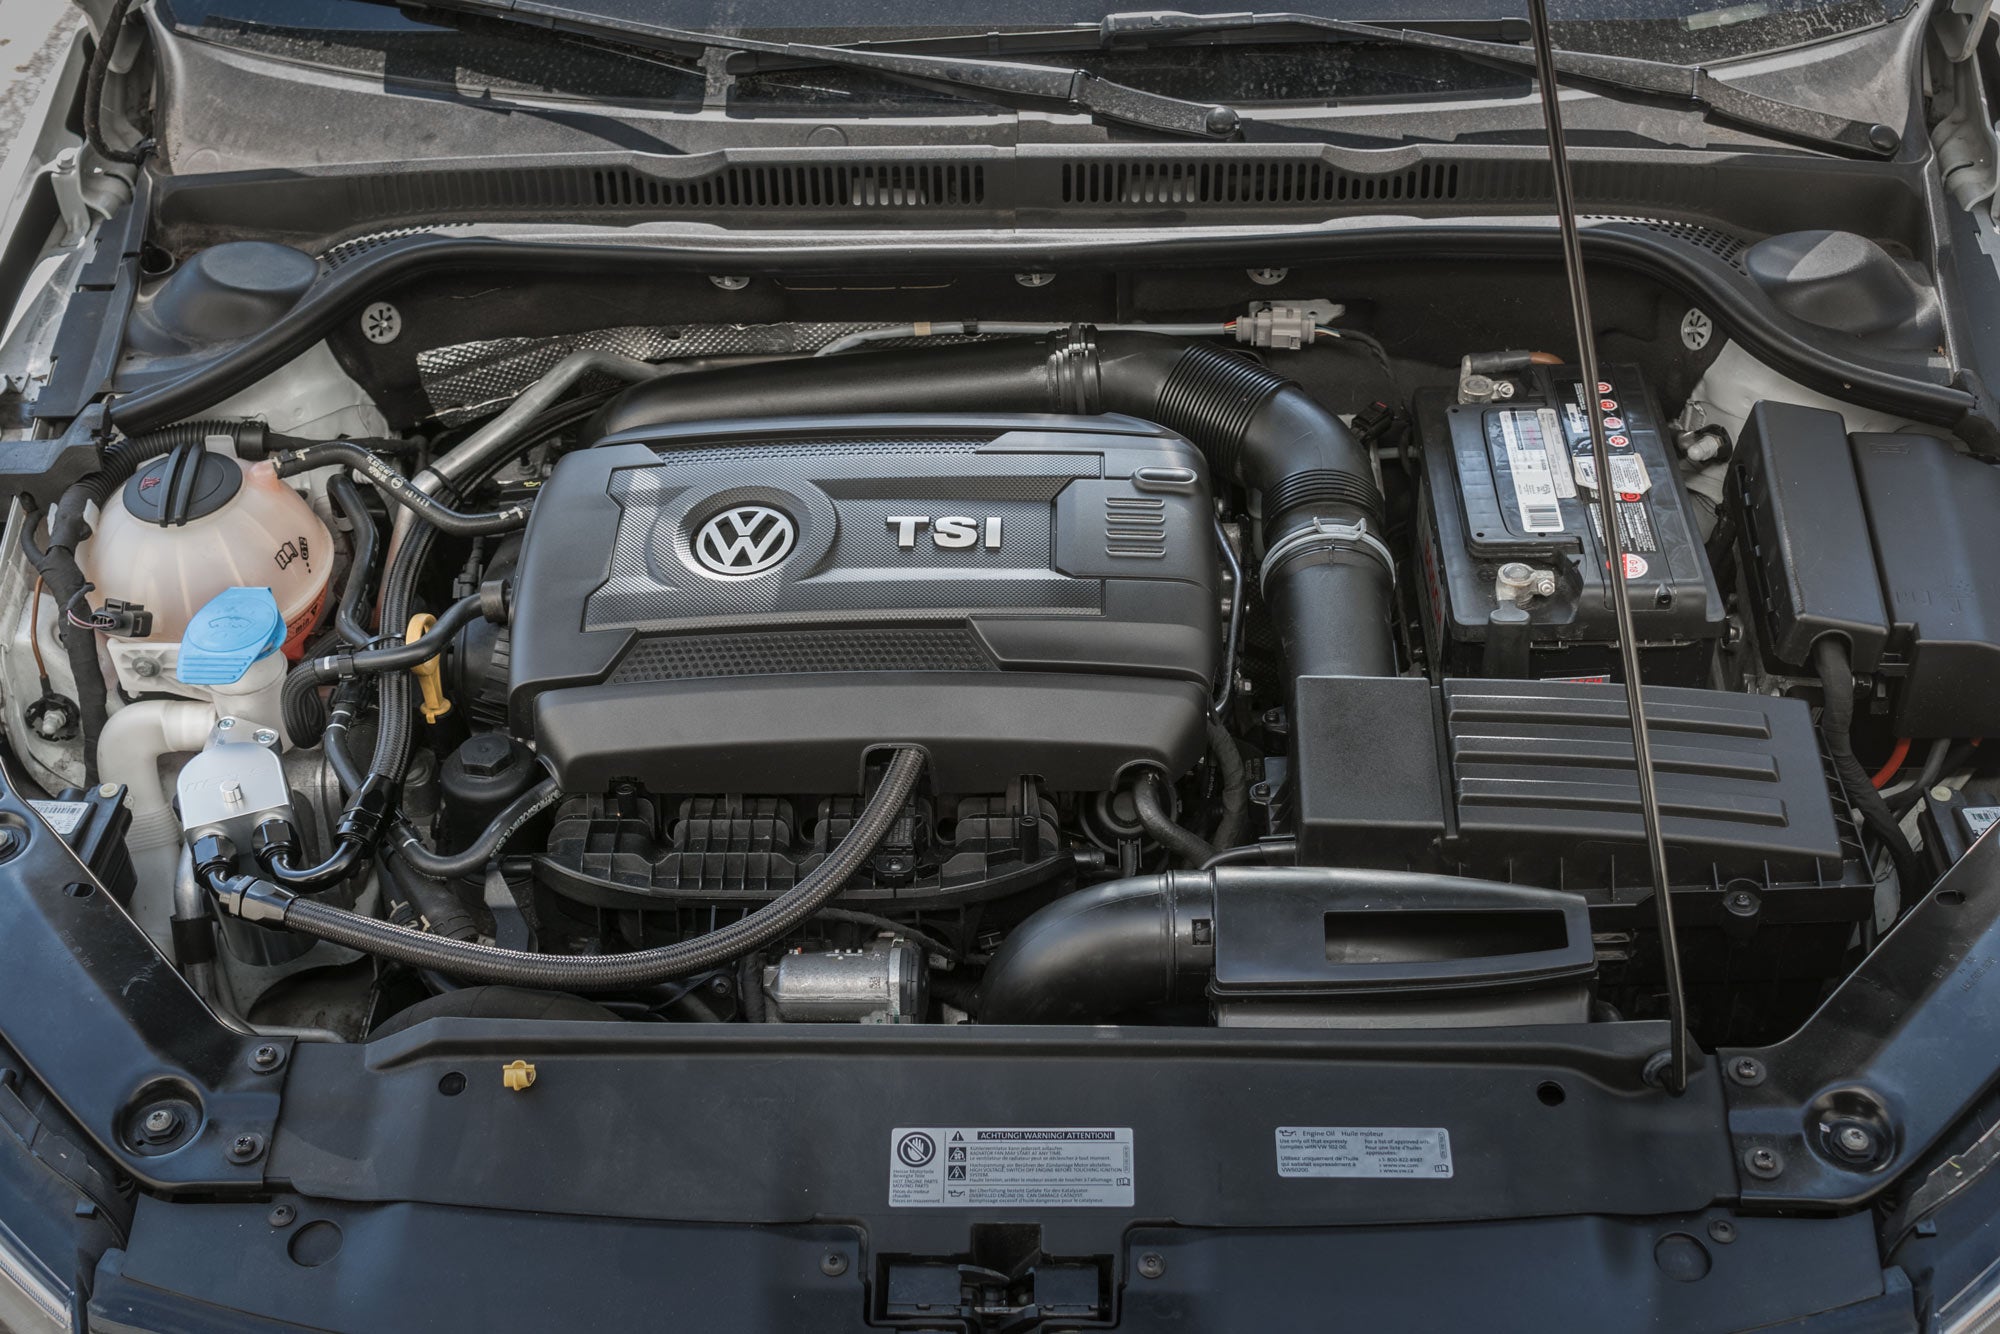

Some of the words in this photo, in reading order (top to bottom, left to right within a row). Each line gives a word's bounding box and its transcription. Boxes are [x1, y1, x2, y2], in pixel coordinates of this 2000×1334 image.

[696, 506, 794, 574] VW
[886, 515, 1002, 549] TSI
[295, 618, 310, 634] min
[980, 1132, 1022, 1140] ACHTUNG!
[1024, 1132, 1065, 1140] WARNING!
